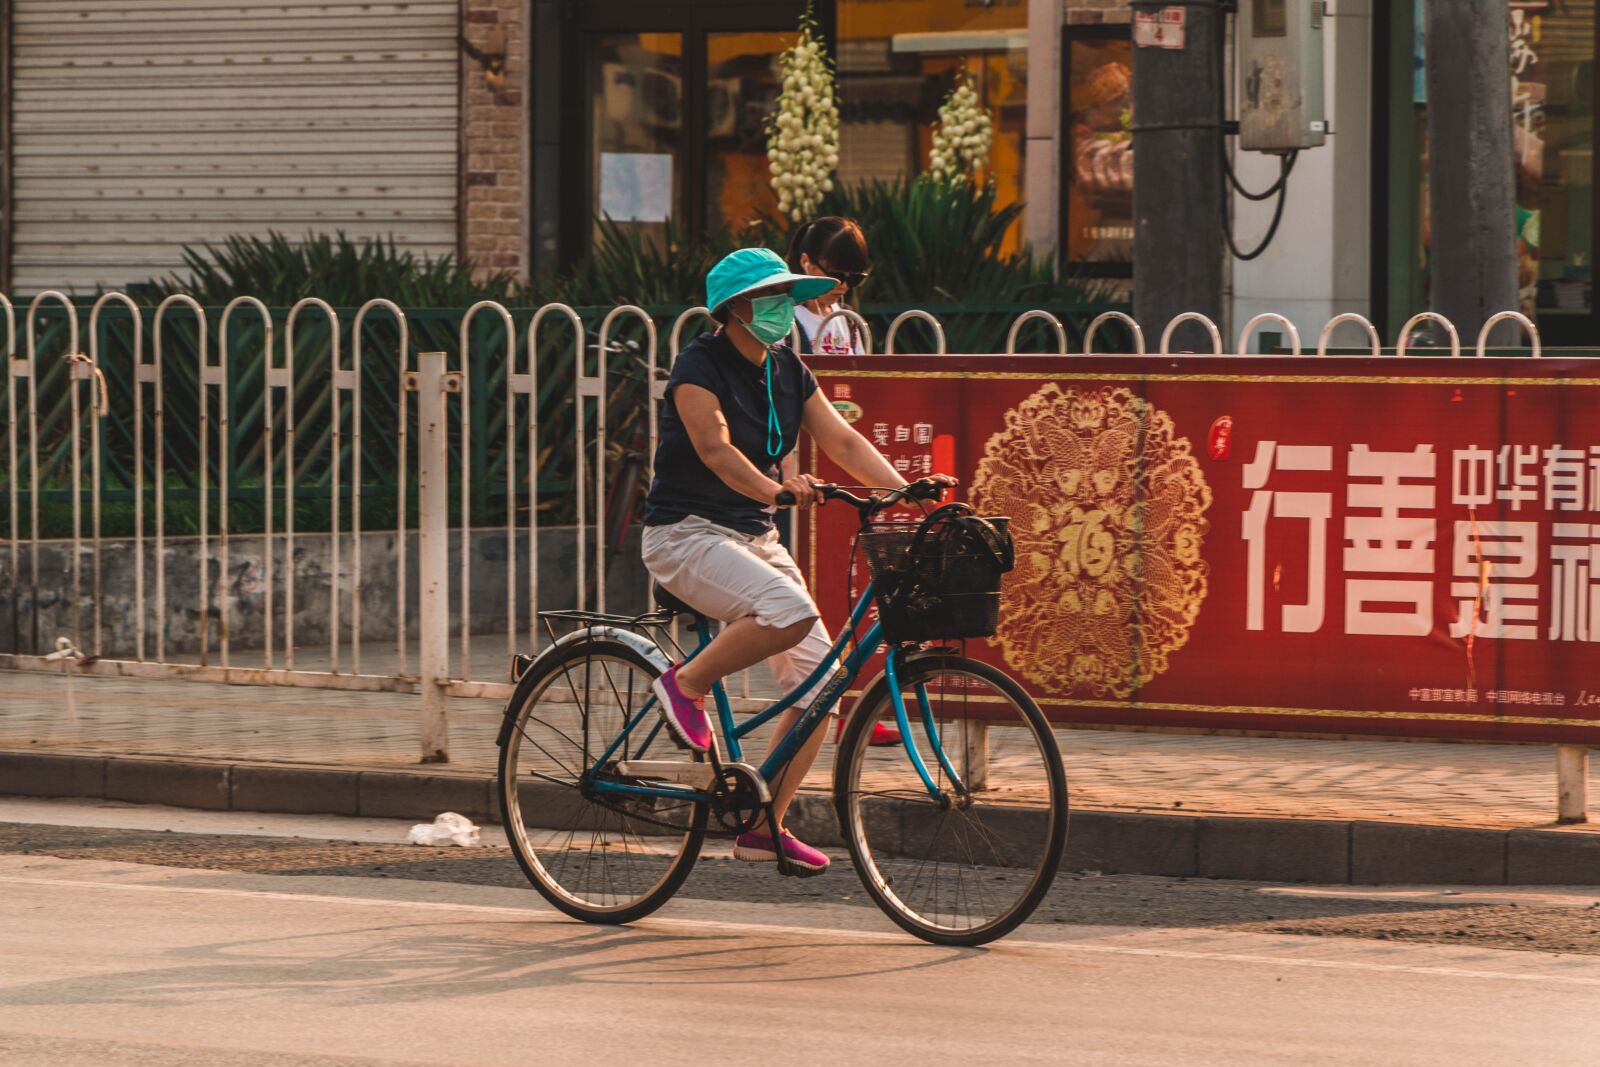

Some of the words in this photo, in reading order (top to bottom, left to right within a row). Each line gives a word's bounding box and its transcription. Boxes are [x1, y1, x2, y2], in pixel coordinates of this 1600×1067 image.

[1241, 440, 1436, 636] 行善
[1451, 444, 1600, 512] 中华有
